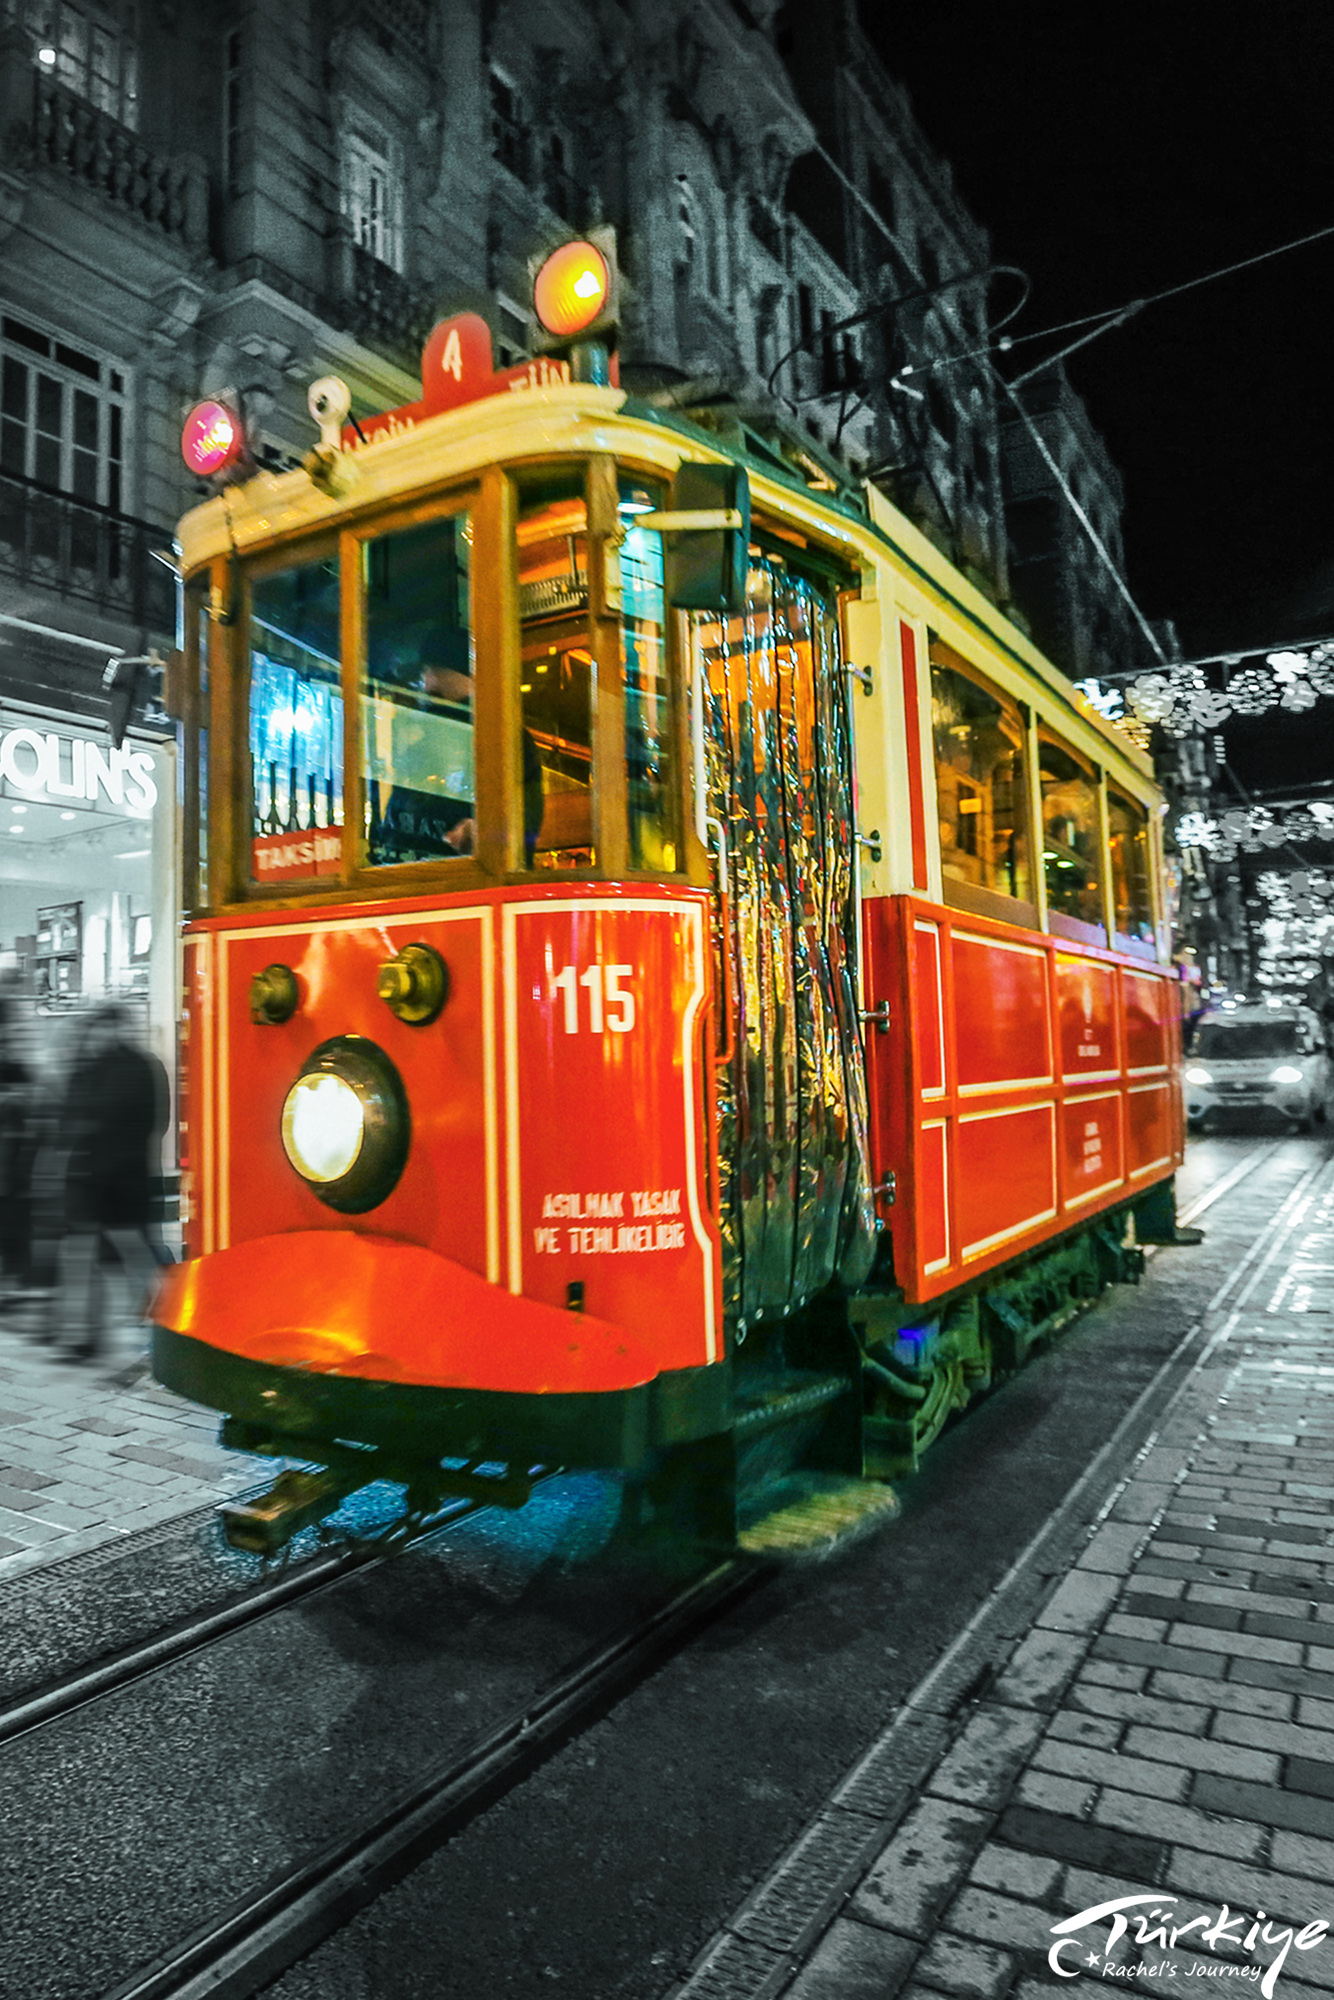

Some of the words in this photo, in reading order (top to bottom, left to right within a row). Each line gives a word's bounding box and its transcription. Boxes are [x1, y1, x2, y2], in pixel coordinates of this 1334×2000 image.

[441, 328, 463, 382] 4
[0, 728, 158, 811] OLIN'S
[555, 964, 635, 1034] 115
[542, 1192, 624, 1219] ASILMAK
[630, 1188, 681, 1218] YASAK
[533, 1226, 561, 1254] VE
